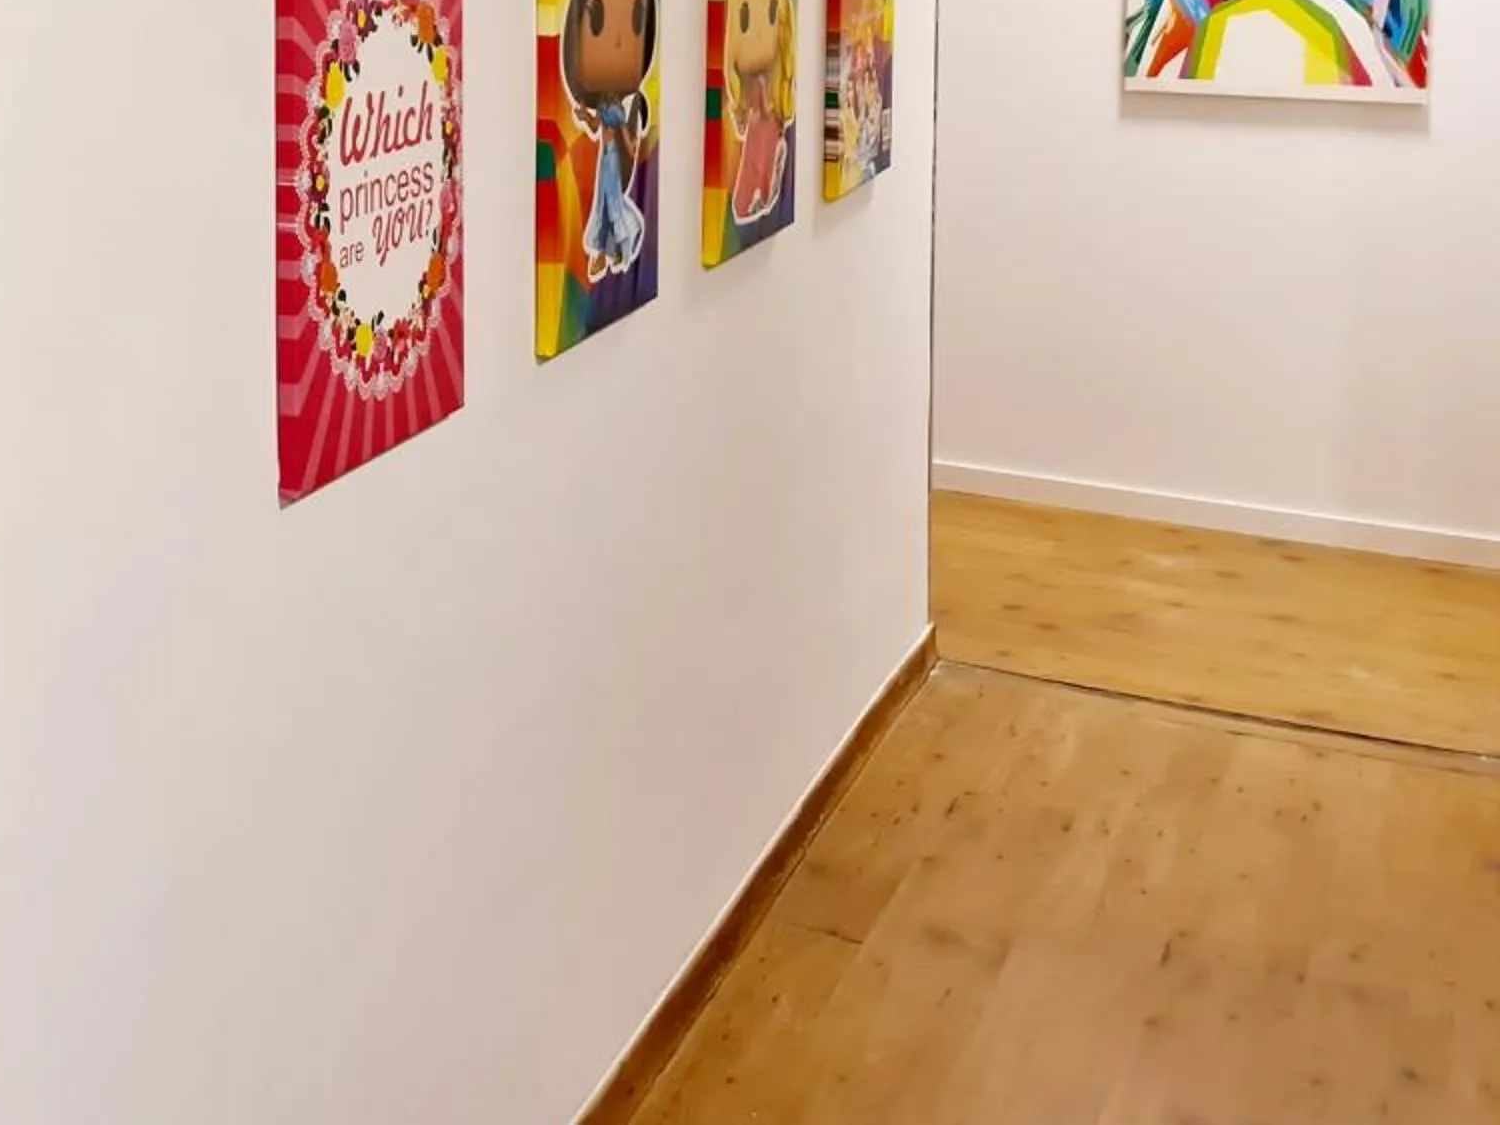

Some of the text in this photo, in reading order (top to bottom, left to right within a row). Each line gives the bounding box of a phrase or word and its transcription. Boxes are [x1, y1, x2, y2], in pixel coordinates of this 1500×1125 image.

[339, 80, 434, 167] Which
[339, 161, 435, 235] princess
[339, 243, 365, 269] are
